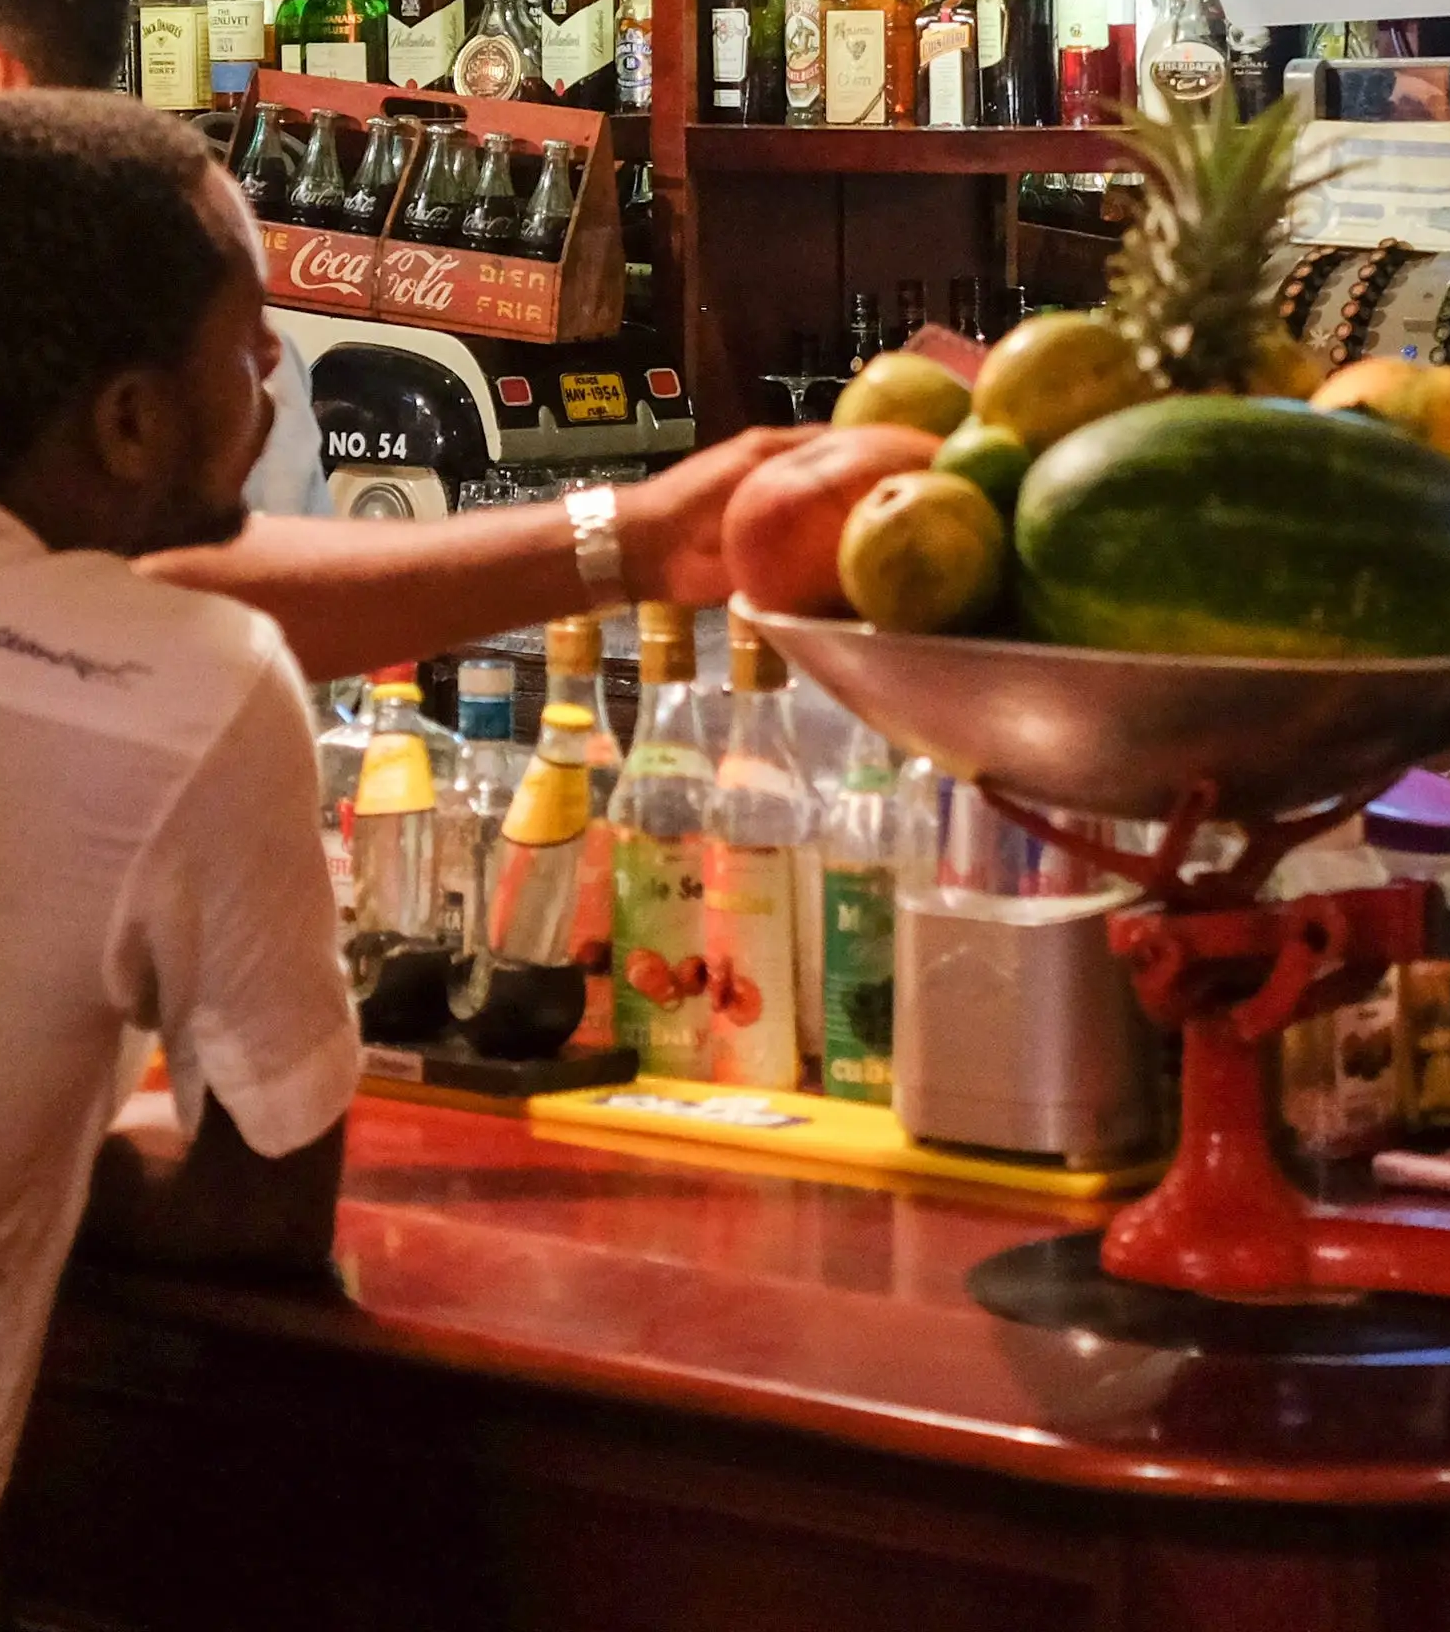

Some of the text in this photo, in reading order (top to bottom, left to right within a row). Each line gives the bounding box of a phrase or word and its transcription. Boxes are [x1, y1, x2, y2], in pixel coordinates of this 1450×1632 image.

[210, 15, 249, 27] ENLIVET
[328, 431, 408, 460] NO. 54
